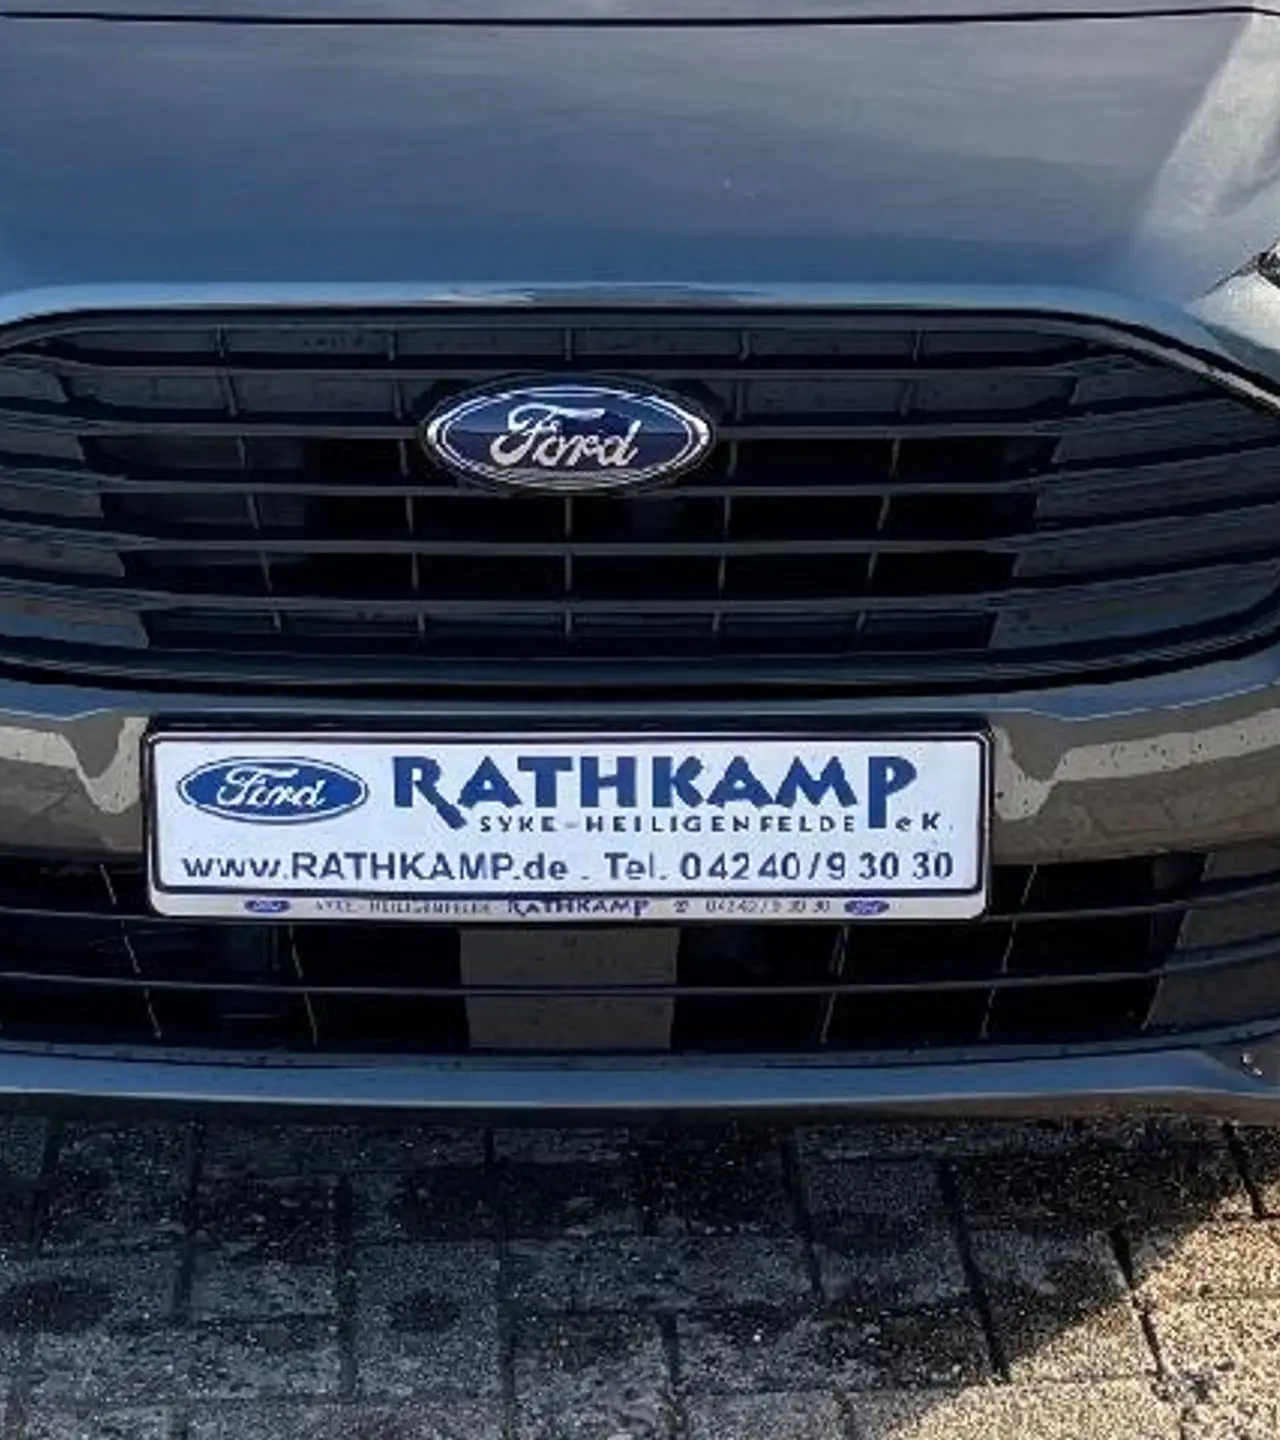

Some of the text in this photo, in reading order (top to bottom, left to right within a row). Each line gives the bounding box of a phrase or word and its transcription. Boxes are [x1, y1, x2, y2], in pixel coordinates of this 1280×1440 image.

[490, 403, 642, 467] Ford
[216, 766, 326, 808] Ford
[392, 755, 918, 831] RATHKAMP
[182, 851, 569, 881] www.RATHKAMP.de
[603, 851, 668, 881] Tel.
[858, 851, 900, 881] 30
[912, 851, 954, 881] 30
